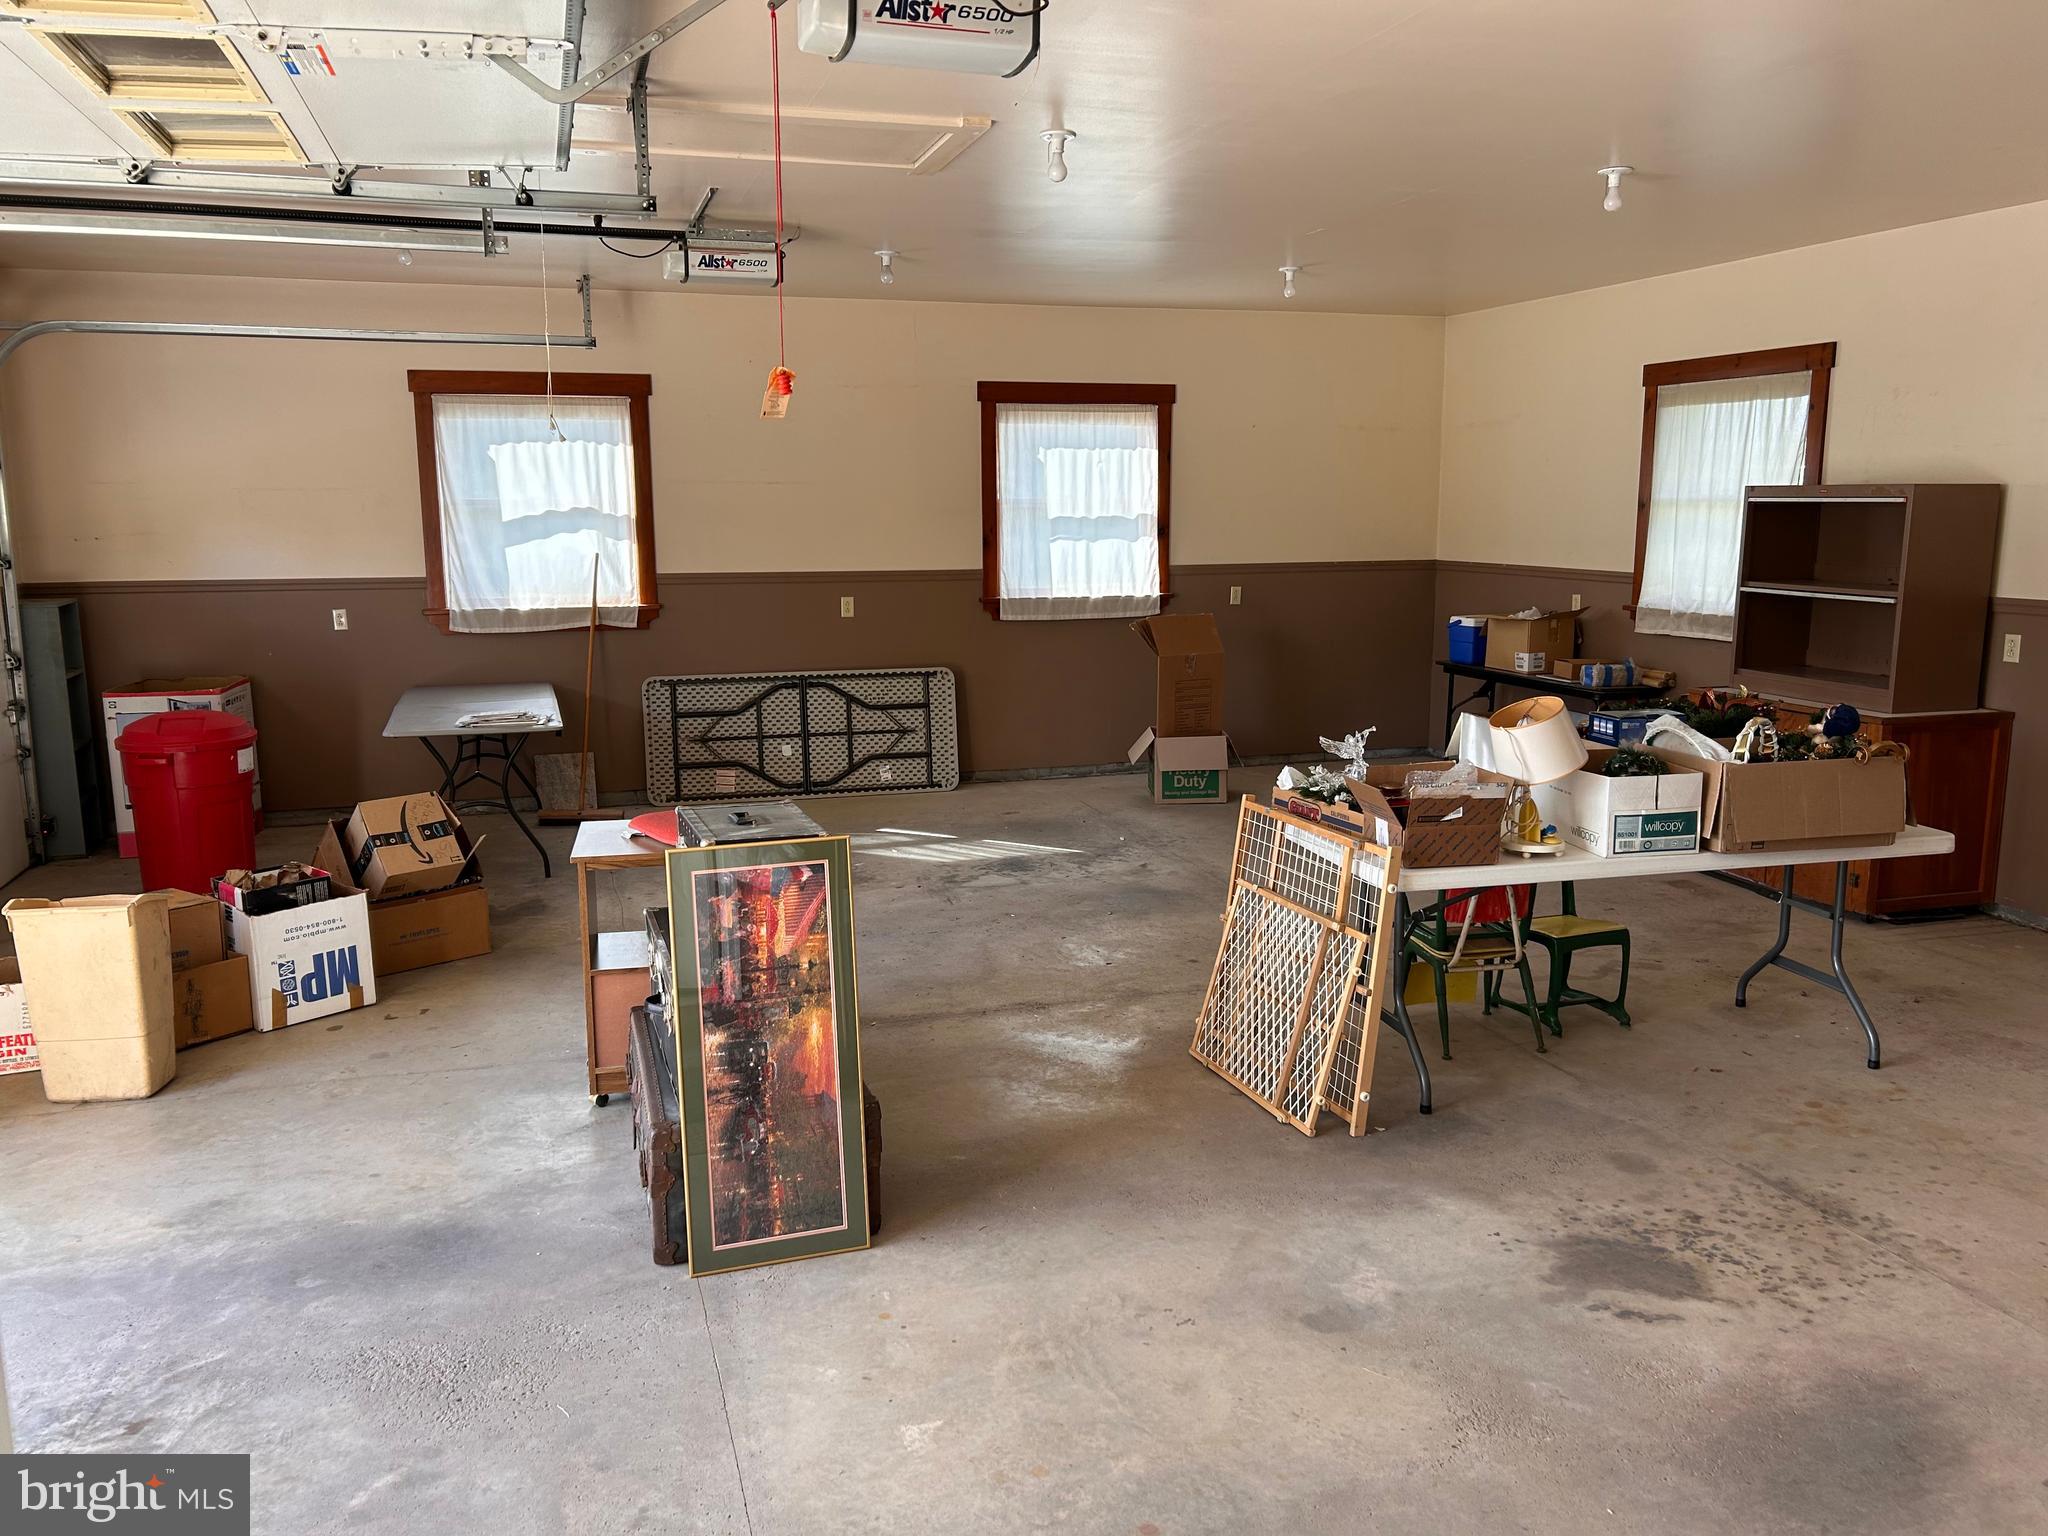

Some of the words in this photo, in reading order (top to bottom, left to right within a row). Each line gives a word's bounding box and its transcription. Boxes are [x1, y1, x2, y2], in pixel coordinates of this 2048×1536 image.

[957, 5, 1014, 22] 6500
[738, 259, 768, 267] 6500
[1174, 775, 1207, 789] Duty
[1644, 820, 1684, 832] willcopy
[1571, 826, 1599, 847] willcopy
[300, 945, 360, 1003] MP
